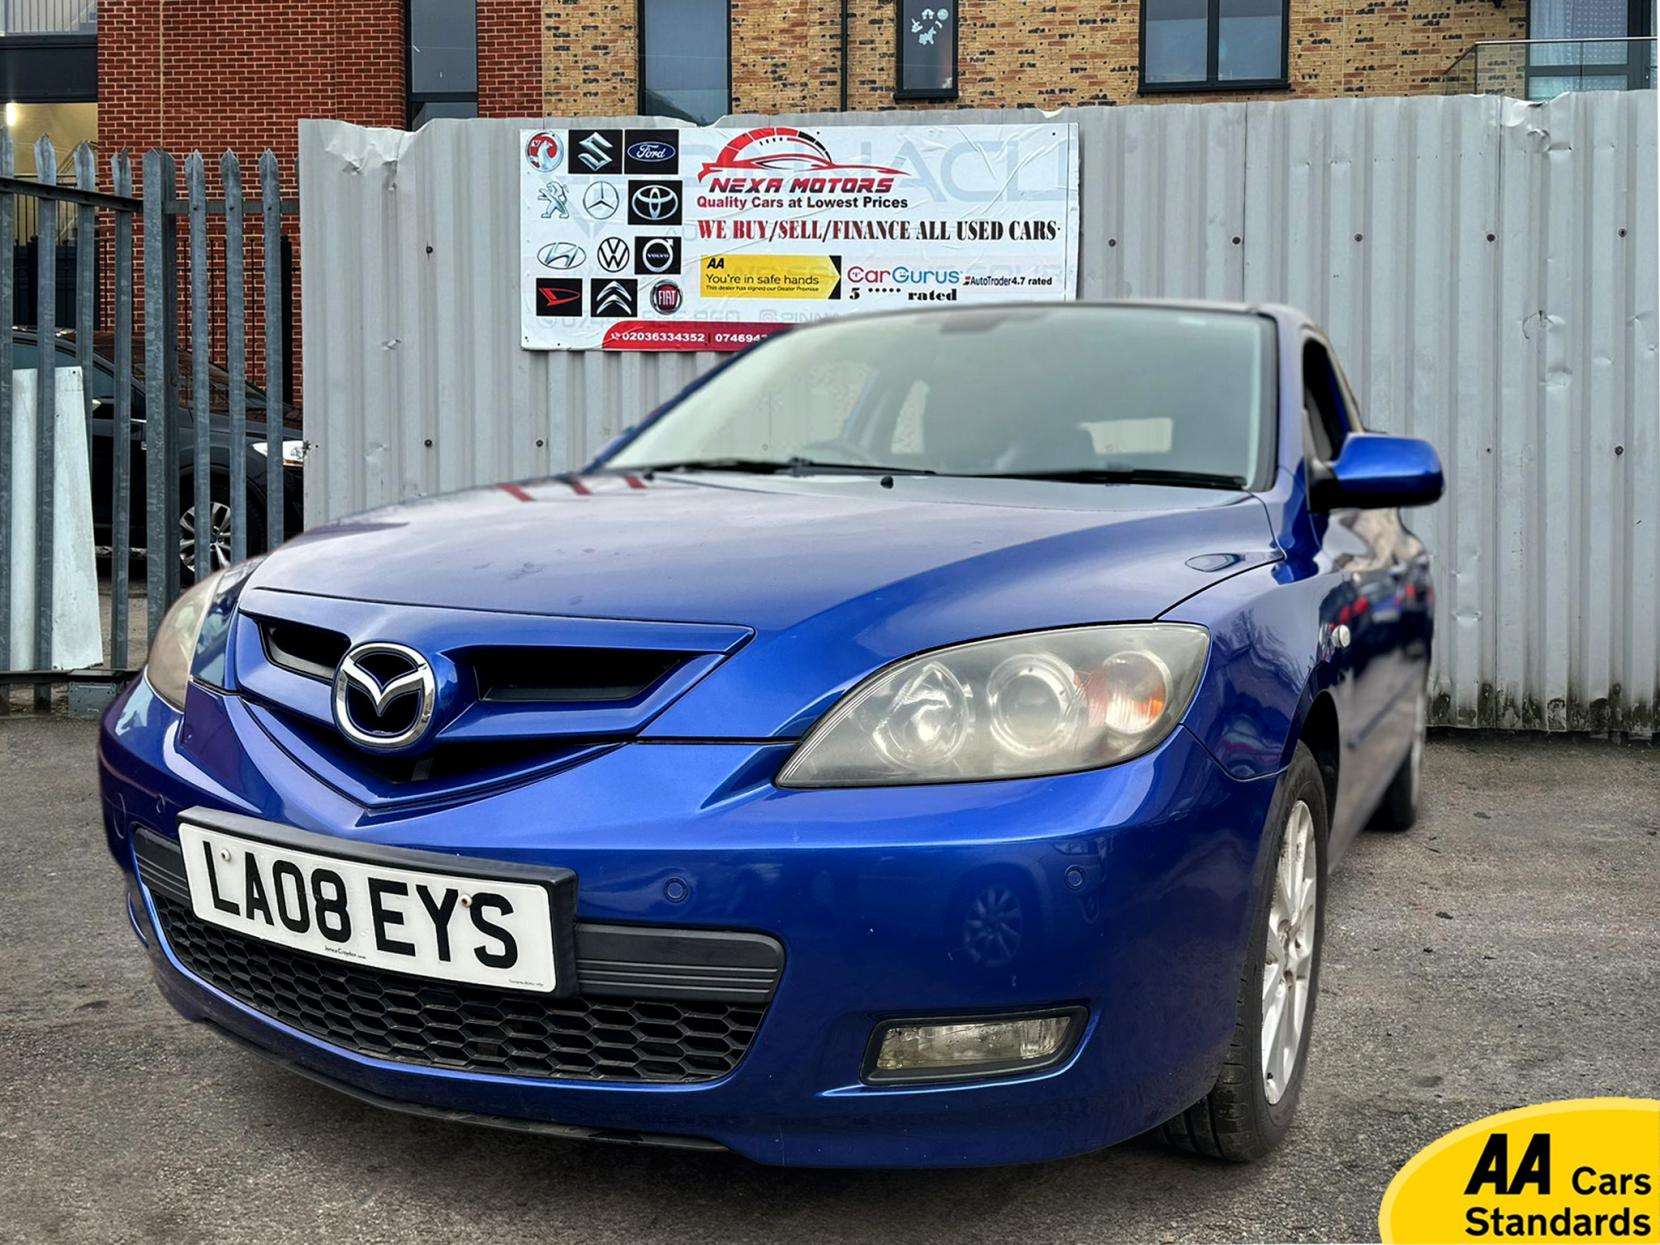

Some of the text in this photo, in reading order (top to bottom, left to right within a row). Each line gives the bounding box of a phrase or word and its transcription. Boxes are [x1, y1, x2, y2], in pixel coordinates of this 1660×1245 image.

[635, 144, 666, 159] Ford
[709, 177, 894, 193] NEXA MOTORS
[697, 196, 908, 210] Quality Cars at Lowest Prices
[697, 220, 727, 240] WE
[733, 219, 911, 242] BUY/SELL/FINANCE
[915, 220, 951, 240] ALL
[956, 220, 1004, 240] USED
[1009, 220, 1057, 241] CARS
[707, 257, 725, 269] AA
[706, 273, 819, 285] You're in safe hands
[847, 266, 960, 284] CarGurus
[1028, 277, 1053, 286] rated
[658, 290, 677, 305] FIAT
[849, 287, 957, 300] 5 rated
[622, 332, 705, 342] 02036334352
[202, 840, 518, 970] LA08 EYS
